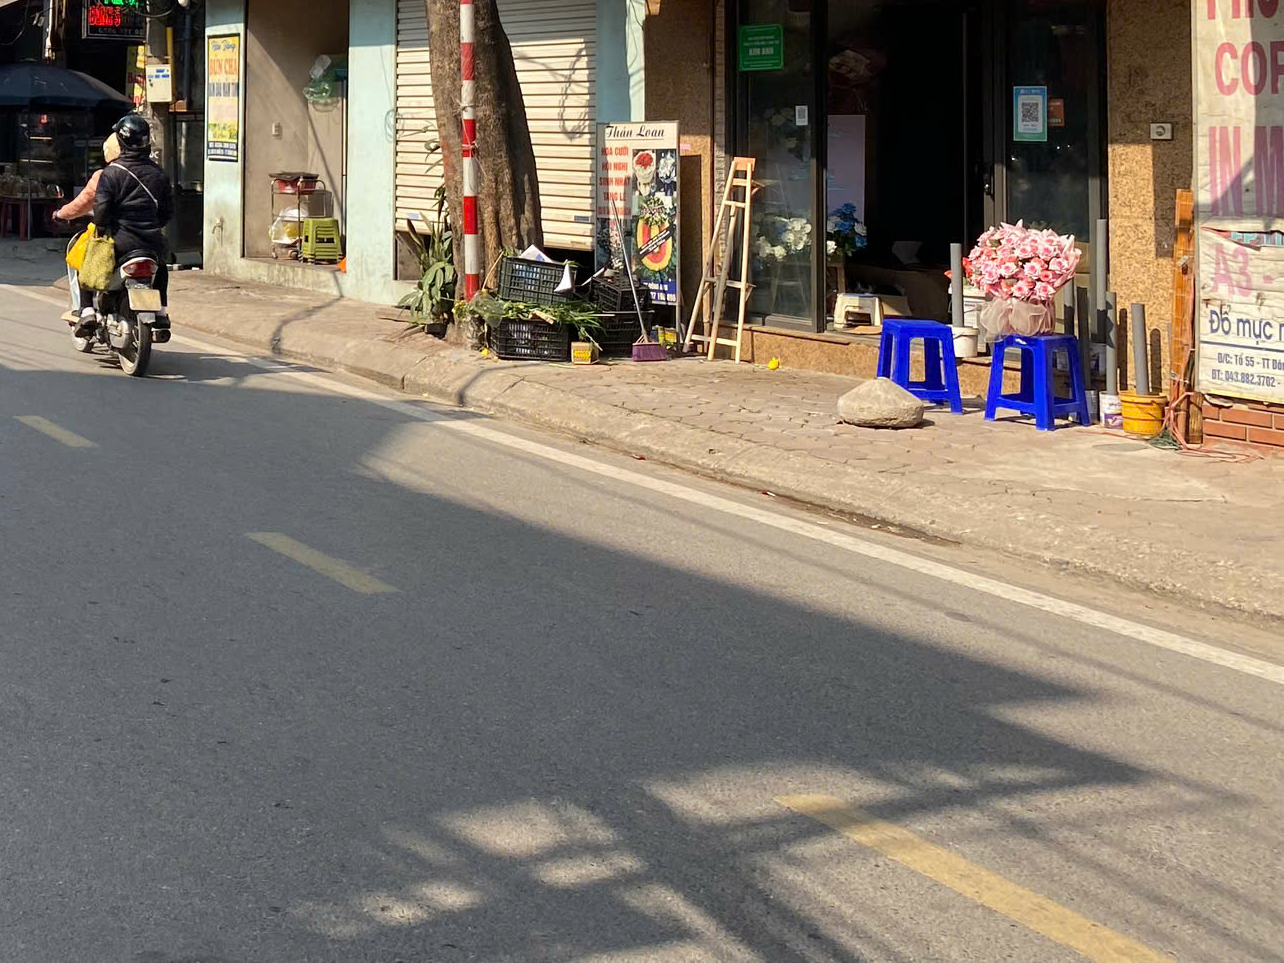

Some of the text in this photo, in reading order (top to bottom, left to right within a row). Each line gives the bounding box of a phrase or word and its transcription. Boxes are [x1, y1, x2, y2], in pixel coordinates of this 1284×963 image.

[636, 124, 665, 137] Loan
[1209, 126, 1242, 217] IN
[1212, 242, 1253, 298] A3
[1237, 317, 1273, 345] mực
[1245, 356, 1255, 367] 55
[1262, 358, 1270, 369] TT
